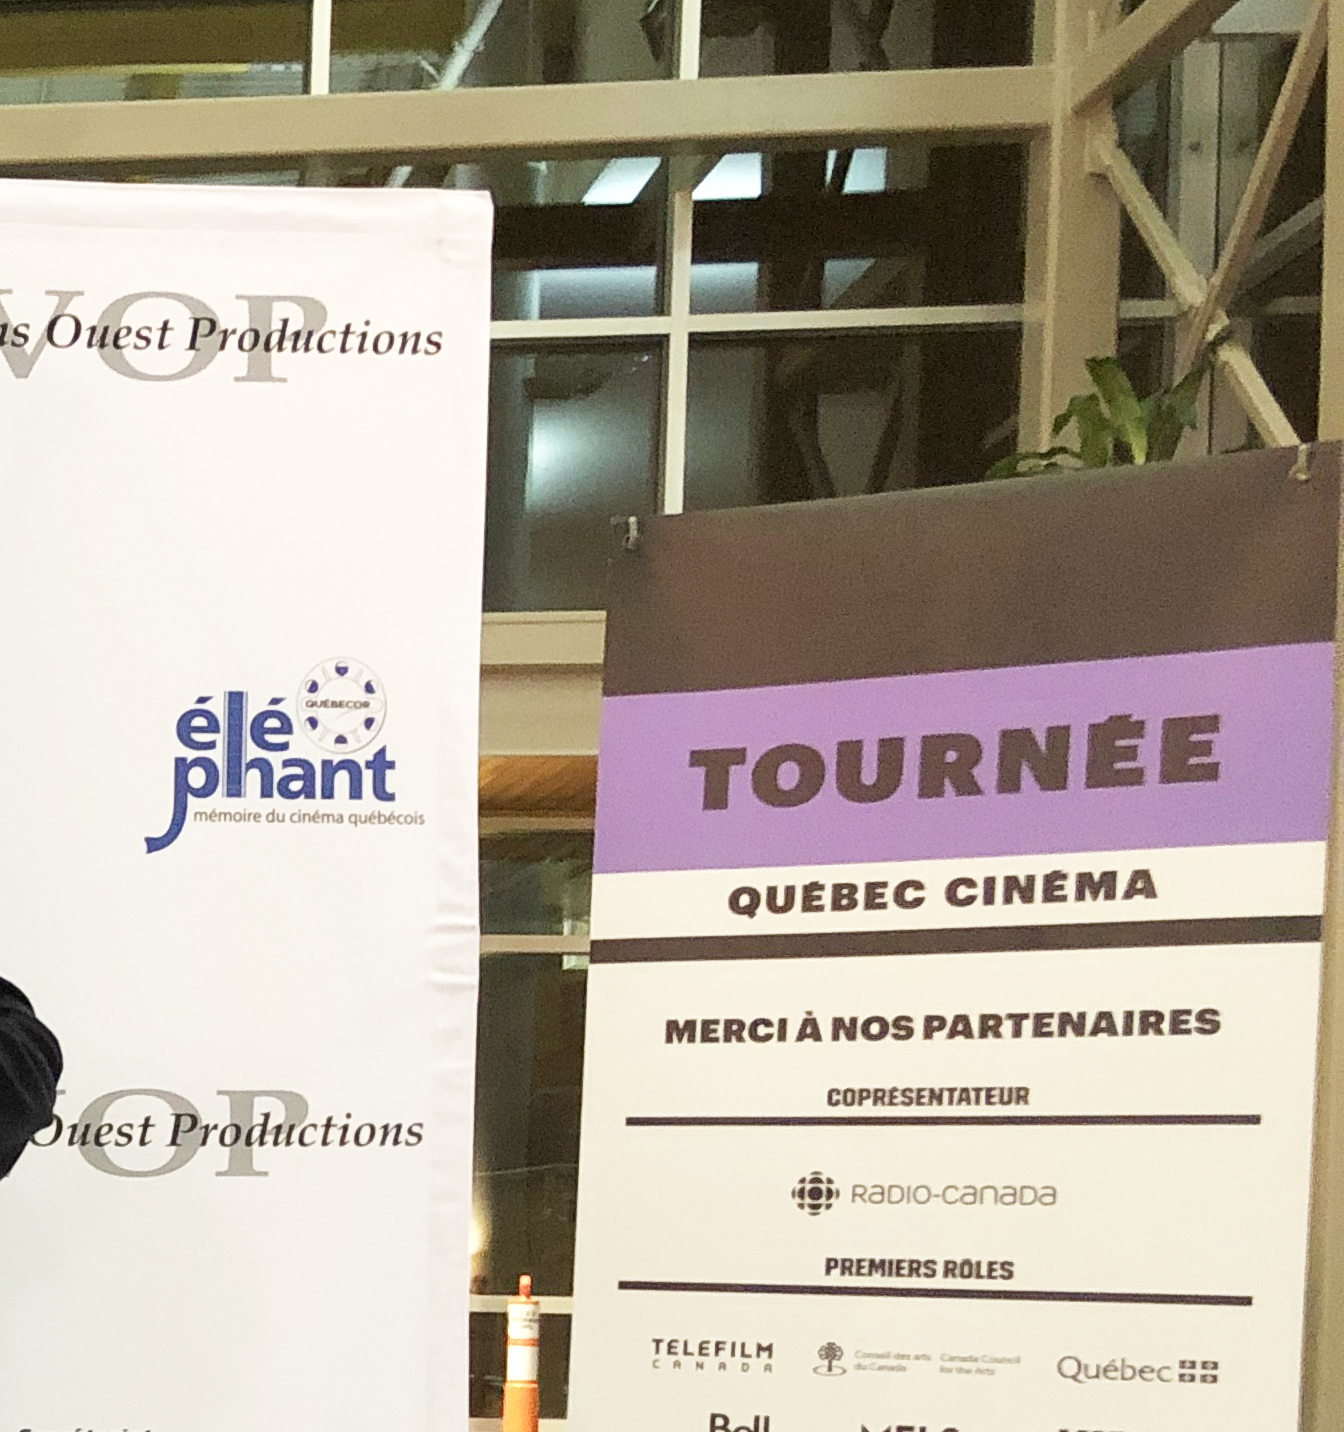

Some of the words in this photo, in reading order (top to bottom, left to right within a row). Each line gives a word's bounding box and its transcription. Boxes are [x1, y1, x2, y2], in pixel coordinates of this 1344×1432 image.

[44, 313, 173, 352] Ouest
[185, 316, 444, 357] Productions
[305, 699, 370, 710] QUÉBECOR
[690, 714, 1221, 811] TOURNÉE
[194, 809, 262, 824] mémoire
[266, 809, 285, 823] du
[289, 809, 344, 824] cinéma
[348, 810, 425, 827] québécois
[728, 880, 925, 919] QUÉBEC
[944, 869, 1158, 907] CINÉMA
[665, 1016, 788, 1045] MERCI
[797, 1010, 823, 1043] À
[831, 1014, 915, 1042] NOS
[923, 1007, 1221, 1041] PARTENAIRES
[827, 1085, 1030, 1108] COPRÉSENTATEUR
[166, 1112, 423, 1150] Productions
[825, 1257, 938, 1279] PREMIERS
[942, 1256, 1014, 1280] RÔLES
[652, 1338, 773, 1359] TELEFILM
[1056, 1355, 1173, 1384] Québec
